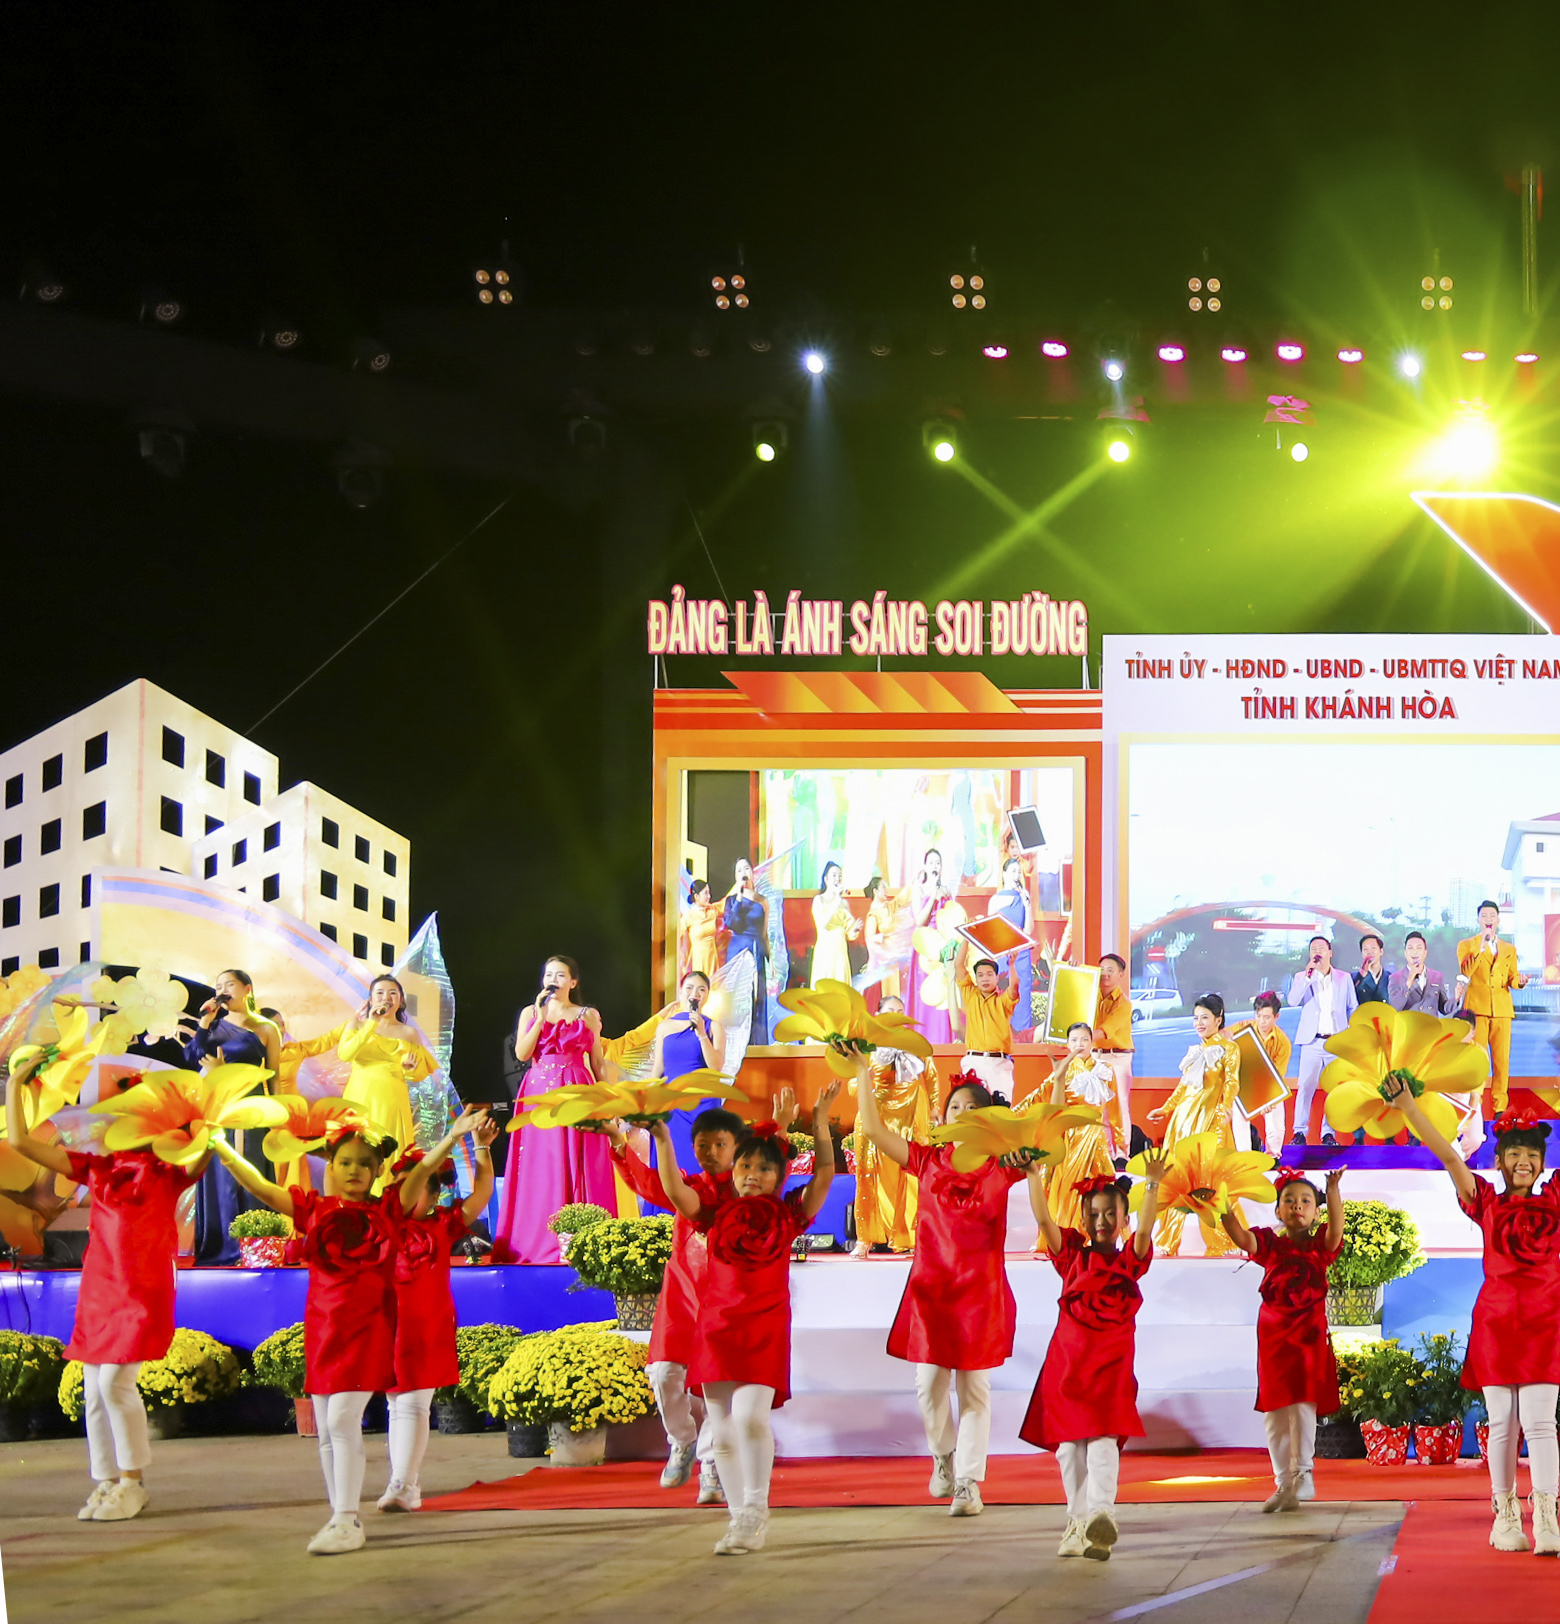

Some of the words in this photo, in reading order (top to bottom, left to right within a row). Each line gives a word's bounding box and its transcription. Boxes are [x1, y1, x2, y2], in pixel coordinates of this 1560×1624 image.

[648, 584, 728, 655] ĐẢNG
[735, 590, 774, 655] LÀ
[781, 590, 843, 655] ÁNH
[849, 590, 928, 656] SÁNG
[934, 600, 983, 656] SOI
[990, 590, 1088, 656] ĐƯỜNG
[1125, 651, 1173, 679] TỈNH
[1179, 651, 1208, 679] ỦY
[1226, 659, 1288, 679] HĐND
[1306, 659, 1365, 679] UBND
[1383, 658, 1469, 680] UBMTTQ
[1473, 653, 1517, 685] VIỆT
[1241, 687, 1298, 720] TỈNH
[1305, 689, 1394, 720] KHÁNH
[1401, 689, 1459, 720] HÒA
